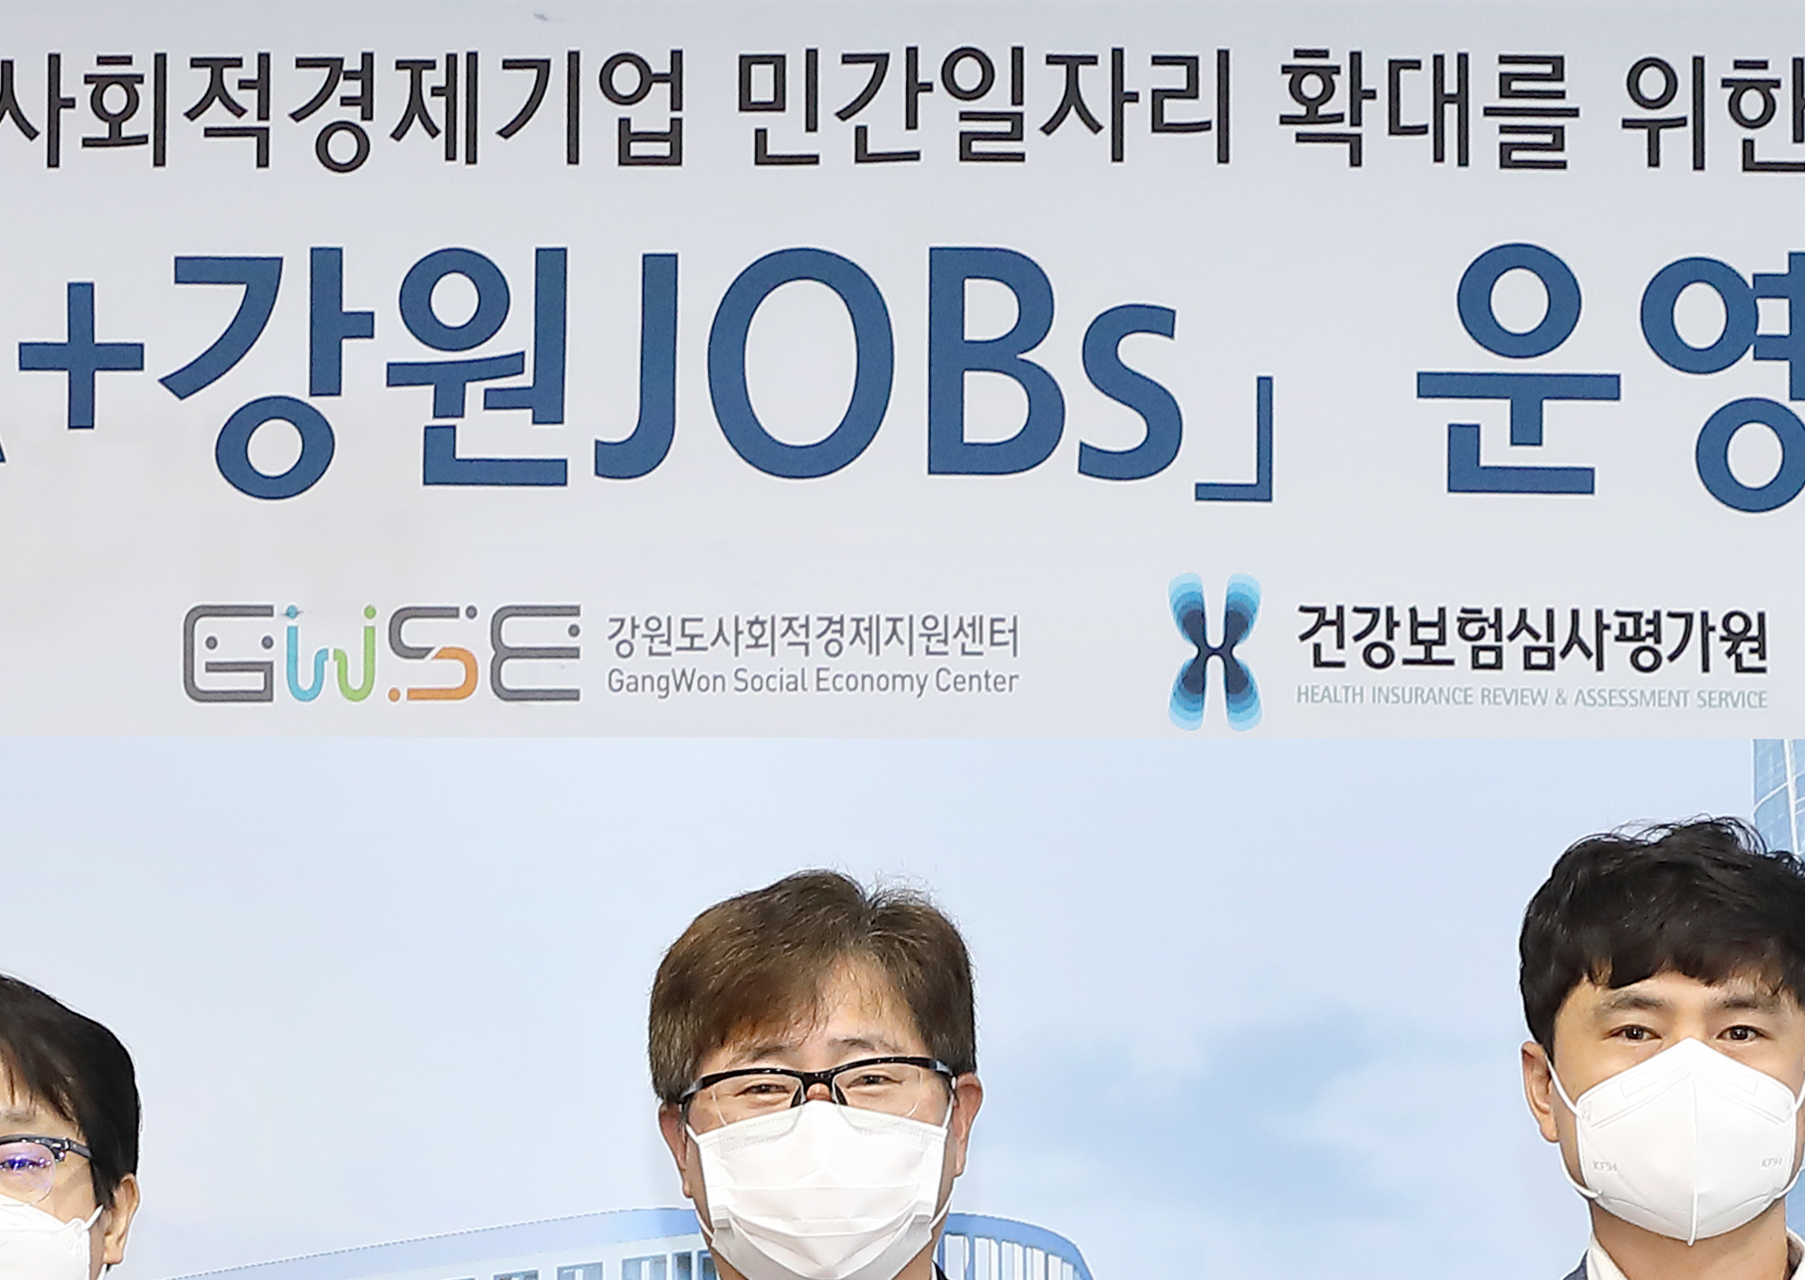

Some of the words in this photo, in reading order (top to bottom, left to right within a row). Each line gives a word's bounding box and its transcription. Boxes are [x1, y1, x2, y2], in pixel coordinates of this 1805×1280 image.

[738, 46, 1230, 166] 민간일자리
[1279, 49, 1579, 170] 확대를
[607, 614, 1018, 659] 강원도사회적경제지원센터
[1298, 604, 1768, 674] 건강보험심사평가원
[608, 668, 726, 699] GangWon
[734, 667, 808, 692] Social
[816, 667, 929, 698] Economy
[935, 667, 1019, 692] Center
[1297, 685, 1364, 704] HEALTH
[1372, 686, 1473, 706] INSURANCE
[1481, 687, 1549, 706] REVIEW
[1555, 688, 1567, 706] &
[1574, 688, 1690, 708] ASSESSMENT
[1697, 690, 1767, 709] SERVICE
